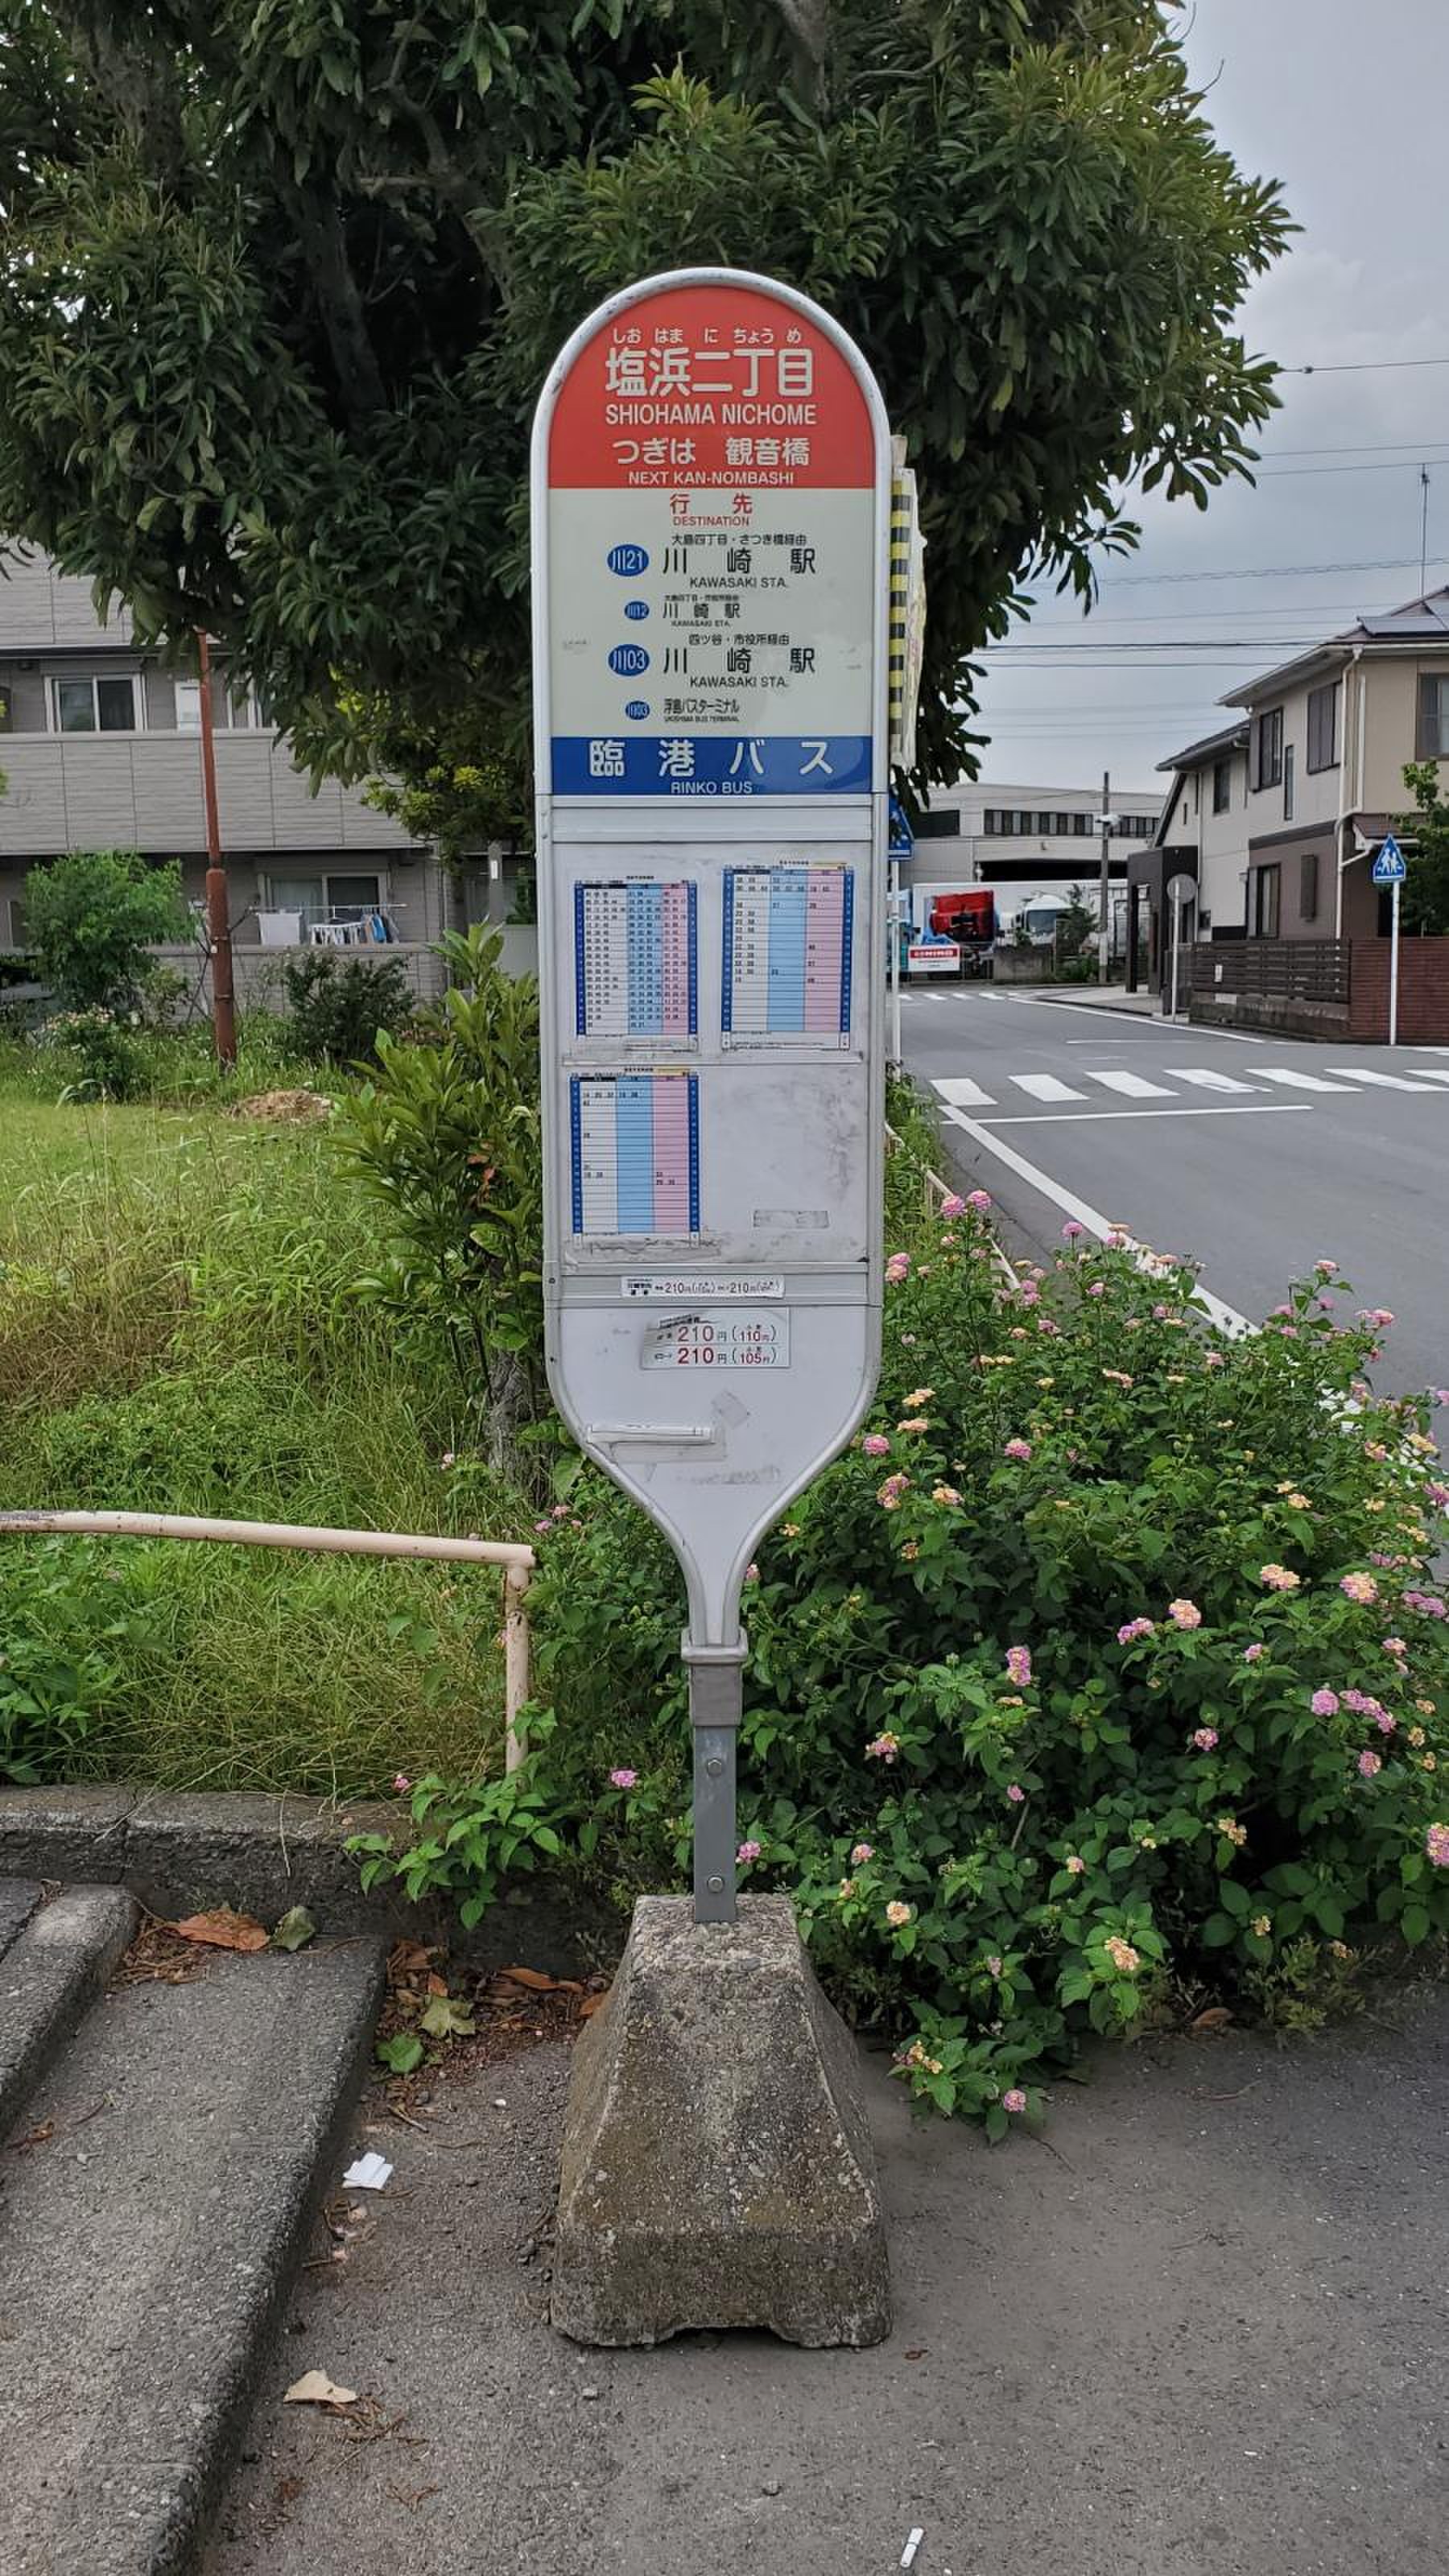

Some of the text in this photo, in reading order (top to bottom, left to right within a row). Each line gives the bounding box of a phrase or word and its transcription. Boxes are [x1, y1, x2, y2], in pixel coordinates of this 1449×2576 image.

[613, 328, 801, 344] しお はま に ちょう め
[605, 347, 813, 397] 塩浜二丁目
[605, 404, 816, 425] SHIOHAMA NICHOME
[613, 438, 810, 466] つぎは 観音橋
[629, 472, 794, 485] NEXT KAN-NOMBASHI
[673, 516, 750, 526] DESTINATION
[663, 547, 816, 574] 川崎駅
[690, 577, 788, 588] KAWASAKI STA.
[663, 646, 815, 673] 川崎駅
[690, 676, 788, 687] KAWASAKI STA.
[588, 738, 834, 777] 臨港バス
[671, 782, 753, 794] RINKO BUS
